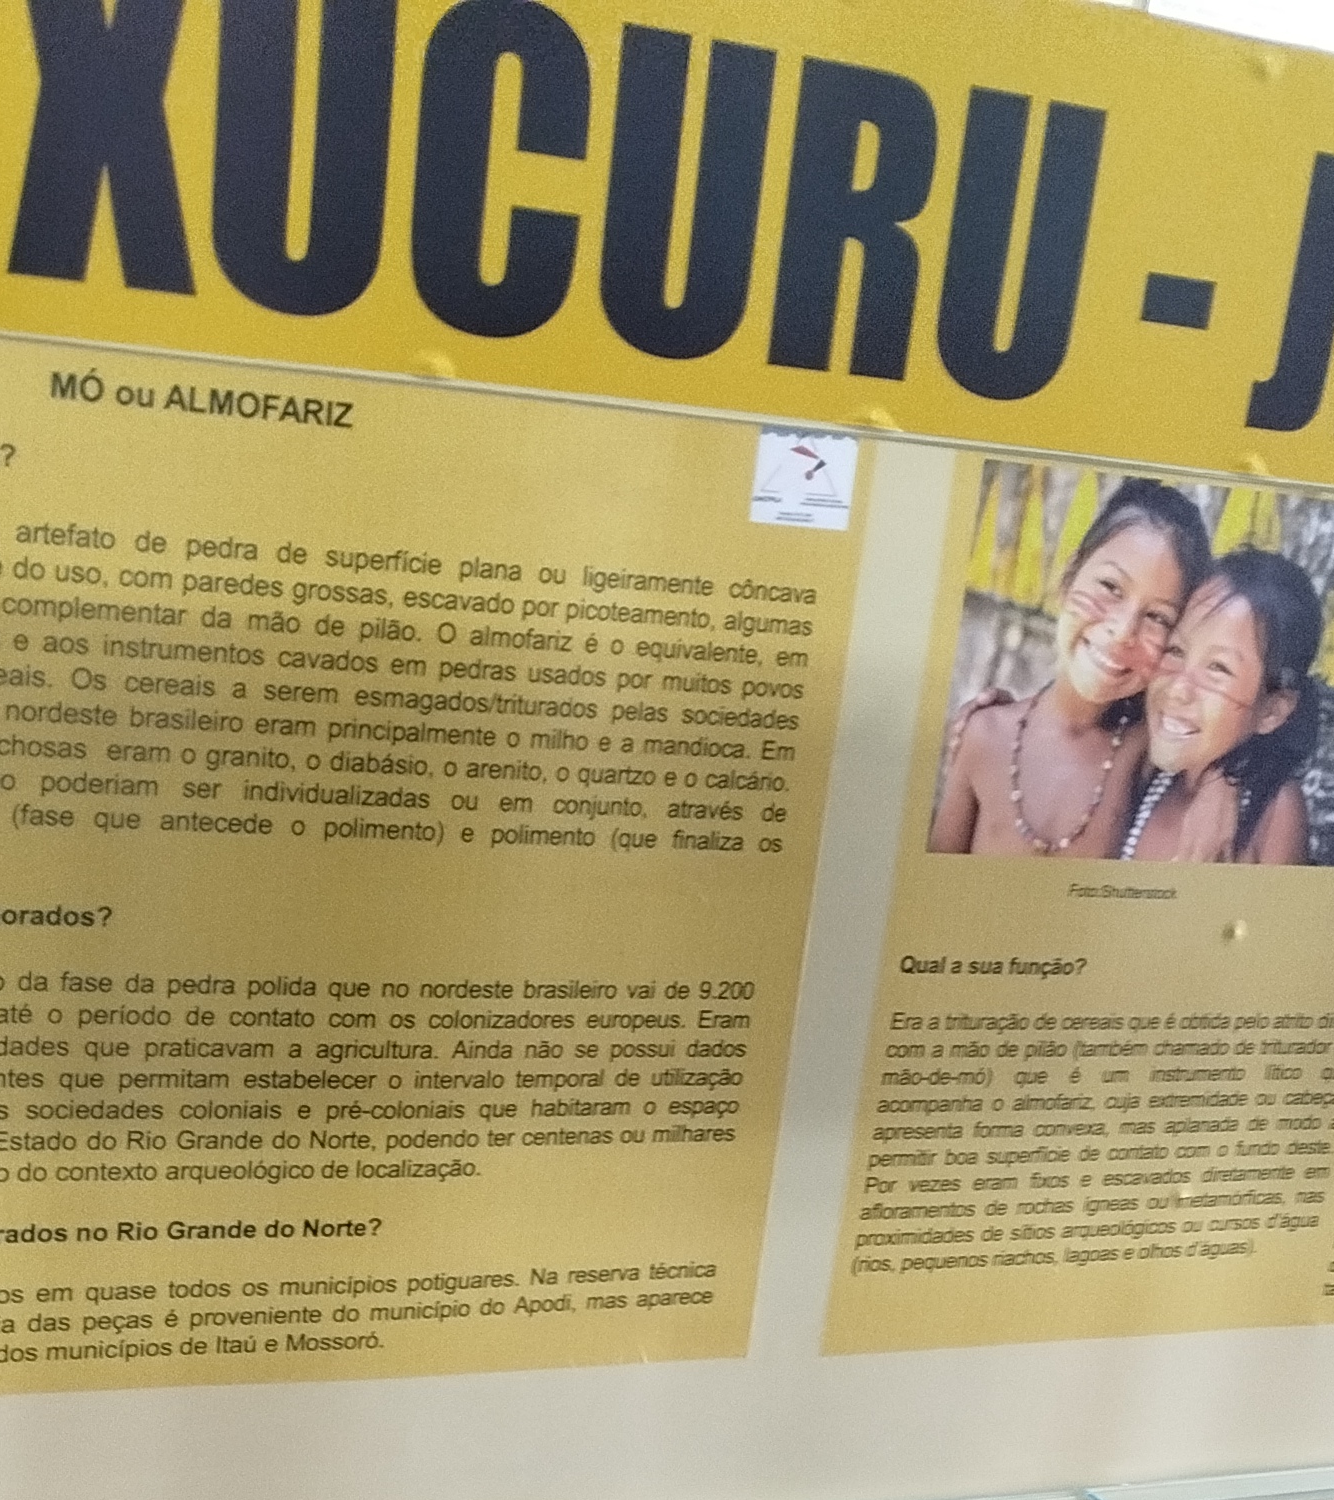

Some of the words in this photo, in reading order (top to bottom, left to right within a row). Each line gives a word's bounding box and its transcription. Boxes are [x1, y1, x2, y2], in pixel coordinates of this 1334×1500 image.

[6, 0, 1107, 400] XUCURU
[50, 366, 105, 402] MÓ
[113, 383, 156, 408] ou
[164, 388, 353, 427] ALMOFARIZ
[11, 554, 46, 580] do
[53, 563, 108, 587] uso,
[117, 568, 173, 589] com
[181, 566, 284, 603] paredes
[290, 581, 393, 611] grossas,
[401, 583, 515, 615] escavado
[520, 598, 560, 624] por
[563, 595, 715, 636] picoteamento,
[722, 607, 813, 643] algumas
[69, 665, 107, 691] Os
[122, 668, 216, 697] cereais
[230, 680, 247, 699] a
[262, 682, 339, 704] serem
[352, 681, 598, 725] esmagados/triturados
[608, 697, 668, 730] pelas
[680, 701, 800, 733] sociedades
[2, 697, 118, 726] nordeste
[127, 703, 245, 733] brasileiro
[252, 716, 317, 736] eram
[325, 713, 497, 752] principalmente
[504, 729, 521, 747] o
[528, 724, 589, 751] milho
[595, 734, 612, 752] e
[618, 735, 634, 754] a
[640, 730, 750, 760] mandioca.
[758, 737, 796, 763] Em
[10, 801, 76, 832] (fase
[92, 810, 142, 835] que
[158, 806, 274, 834] antecede
[289, 817, 307, 835] o
[322, 812, 446, 846] polimento)
[458, 824, 475, 842] e
[489, 819, 597, 852] polimento
[608, 824, 658, 855] (que
[670, 827, 745, 854] finaliza
[756, 837, 783, 856] os
[57, 1072, 106, 1095] que
[116, 1065, 230, 1095] permitam
[241, 1064, 377, 1089] estabelecer
[386, 1070, 403, 1088] o
[412, 1063, 506, 1088] intervalo
[514, 1063, 606, 1093] temporal
[613, 1062, 641, 1086] de
[649, 1061, 744, 1091] utilização
[74, 1221, 109, 1241] no
[114, 1214, 159, 1240] Rio
[165, 1212, 257, 1239] Grande
[262, 1212, 296, 1237] do
[301, 1211, 383, 1237] Norte?
[44, 1331, 173, 1366] municípios
[177, 1330, 209, 1355] de
[214, 1328, 257, 1353] Itaú
[262, 1334, 279, 1352] e
[284, 1324, 384, 1351] Mossoró.
